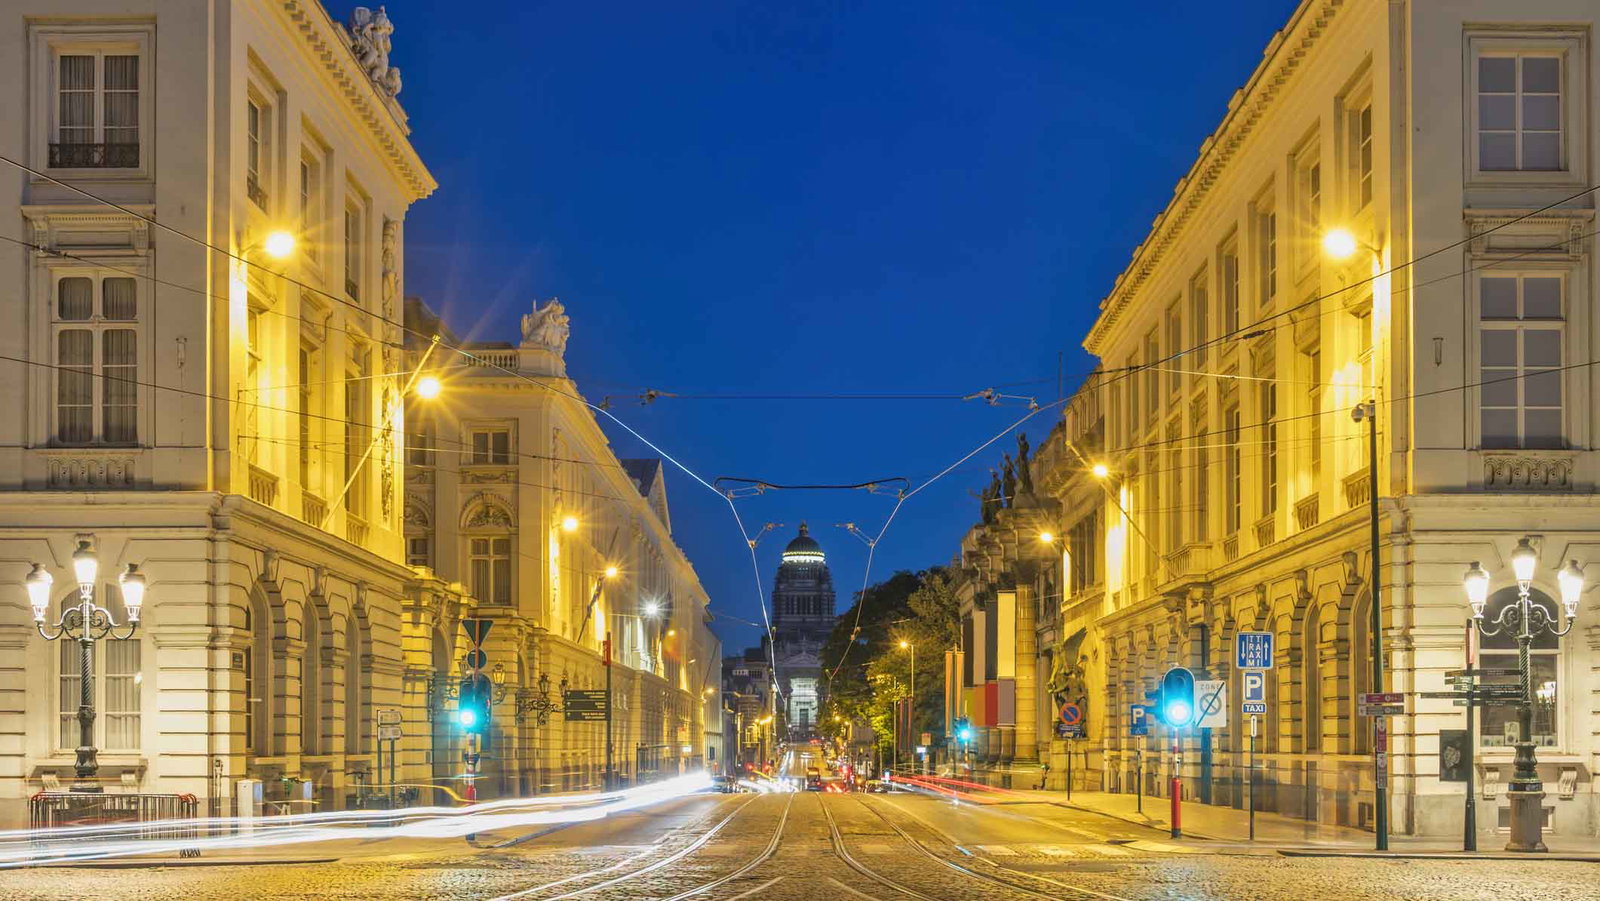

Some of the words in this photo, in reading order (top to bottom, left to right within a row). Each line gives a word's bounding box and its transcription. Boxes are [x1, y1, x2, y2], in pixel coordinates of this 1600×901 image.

[1246, 675, 1262, 698] P
[1132, 708, 1145, 724] P
[1245, 704, 1264, 712] TAXI
